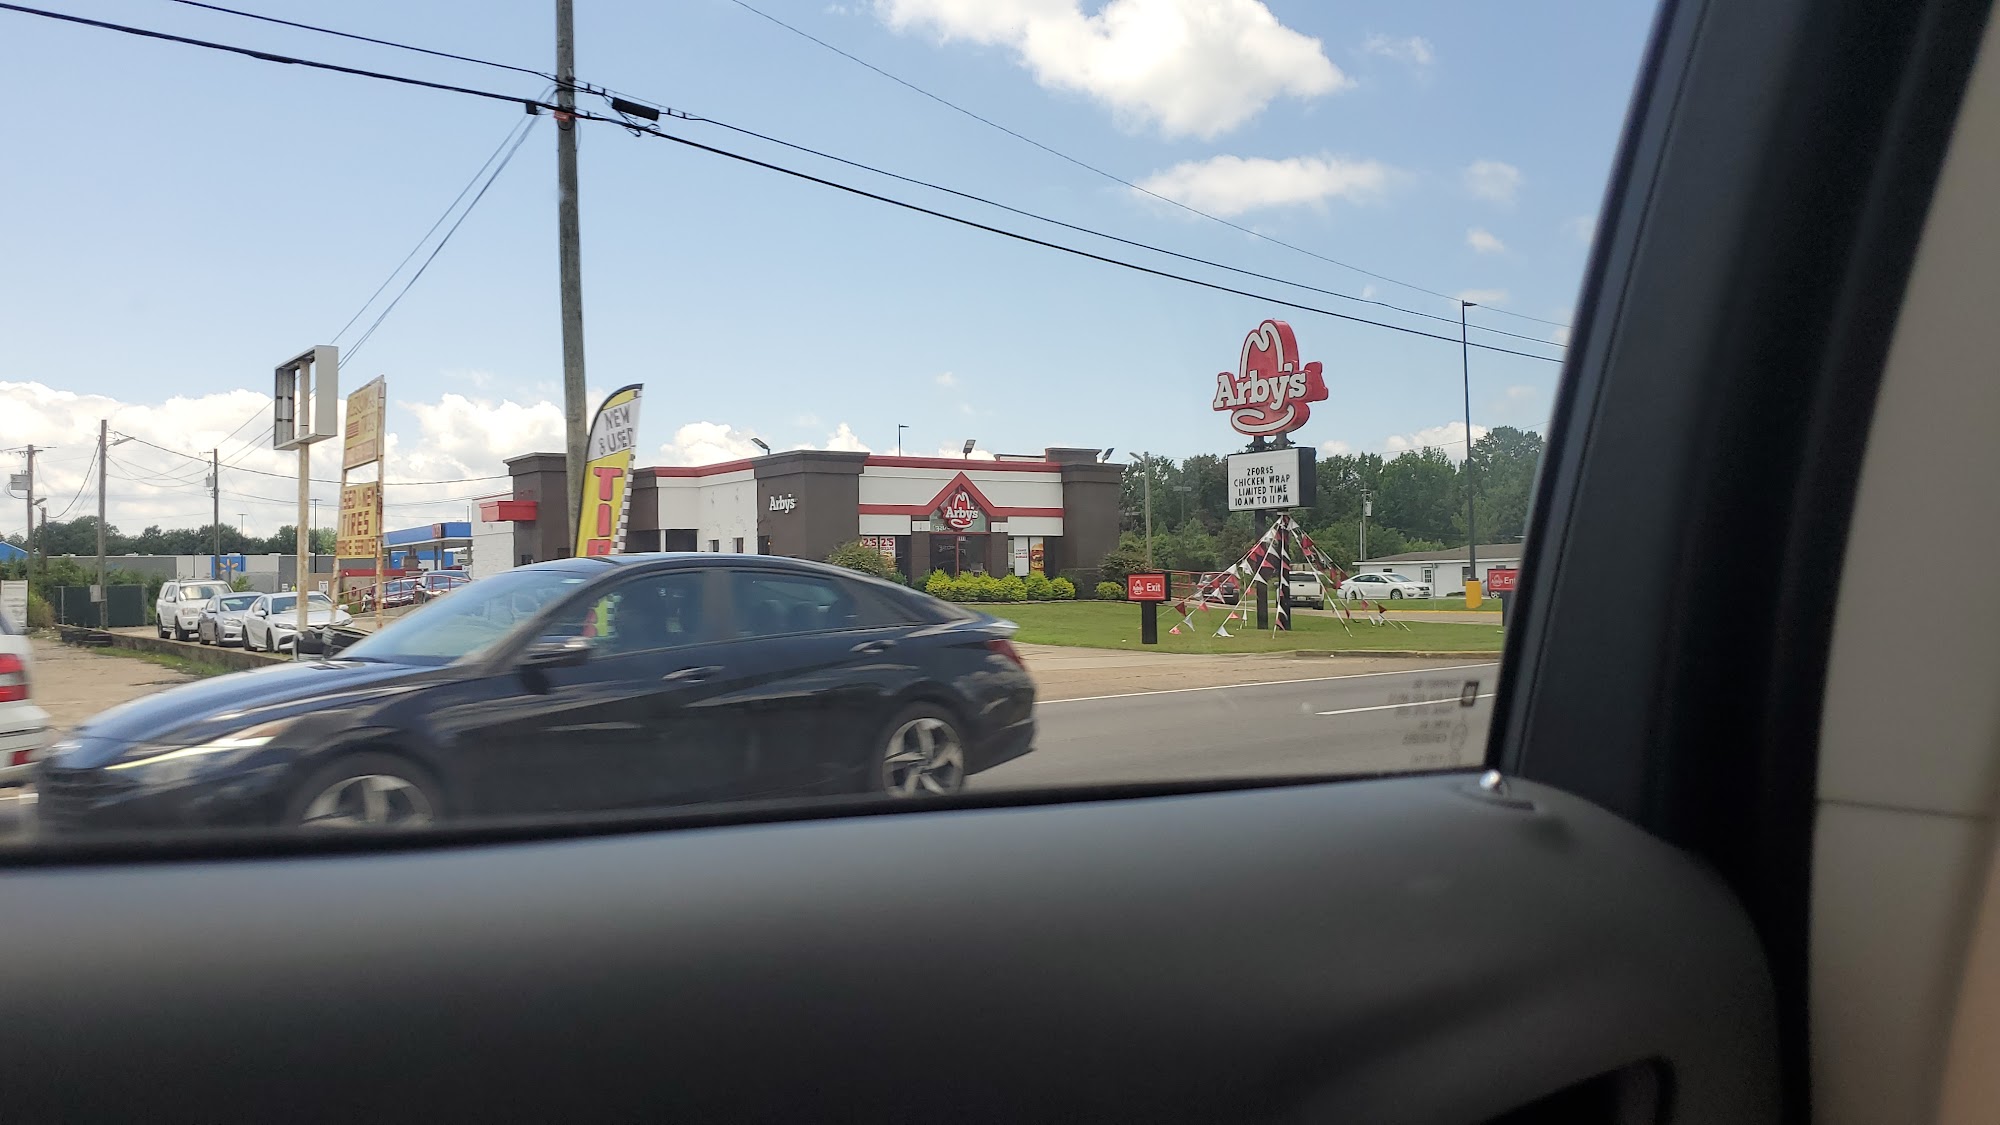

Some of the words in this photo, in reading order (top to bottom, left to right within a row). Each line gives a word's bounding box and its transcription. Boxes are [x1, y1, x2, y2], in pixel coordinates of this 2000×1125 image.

[1213, 362, 1308, 411] Arby's
[604, 404, 630, 431] NEW
[1234, 476, 1265, 487] CHICKEN
[1268, 474, 1290, 484] WRAP
[1238, 486, 1267, 497] LIMITED
[1269, 484, 1287, 494] TIME
[769, 493, 795, 514] Arby's
[1257, 495, 1267, 504] TO
[1277, 494, 1289, 503] PM
[945, 506, 978, 522] Arby's
[342, 510, 370, 537] TIRES
[1146, 582, 1161, 592] Exit
